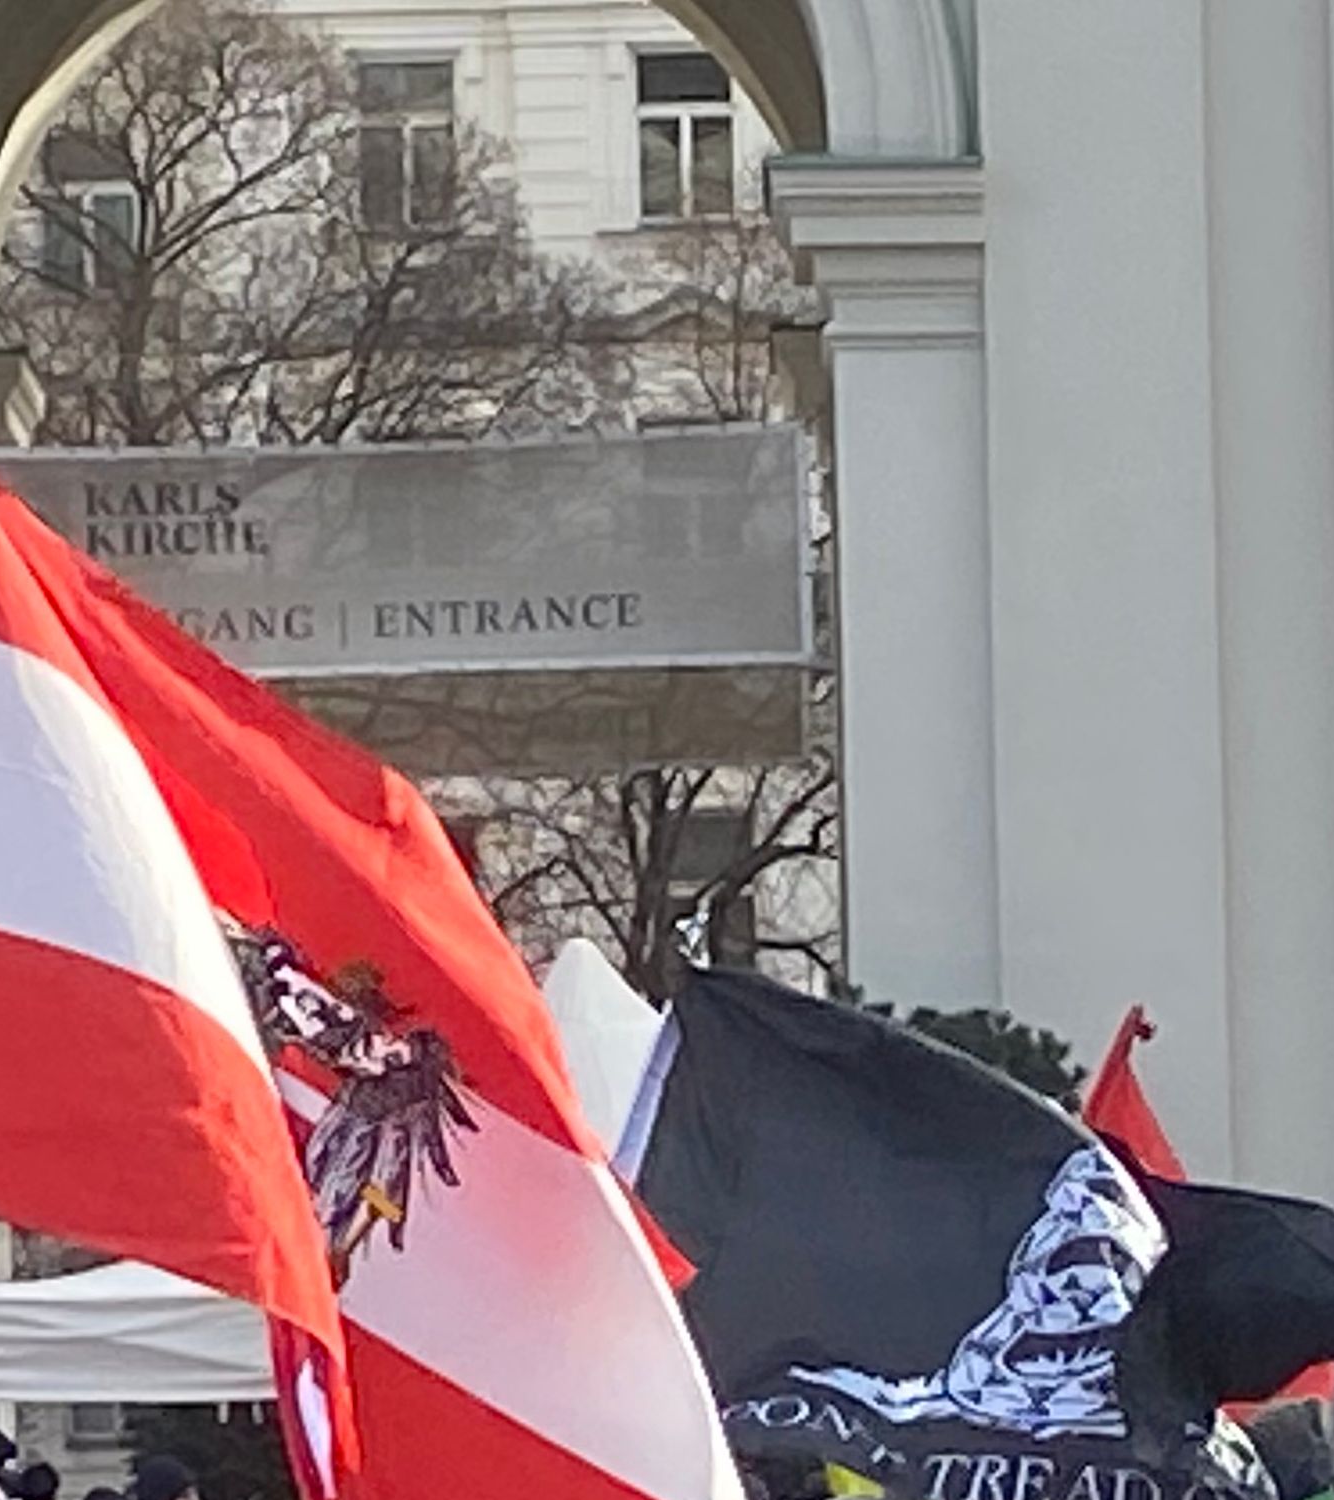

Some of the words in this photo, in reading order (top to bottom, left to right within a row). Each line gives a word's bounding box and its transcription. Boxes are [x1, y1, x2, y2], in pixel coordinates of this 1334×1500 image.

[83, 481, 242, 518] KARLS
[85, 520, 271, 556] KIRCHE
[176, 604, 315, 642] GANG
[373, 593, 642, 638] ENTRANCE
